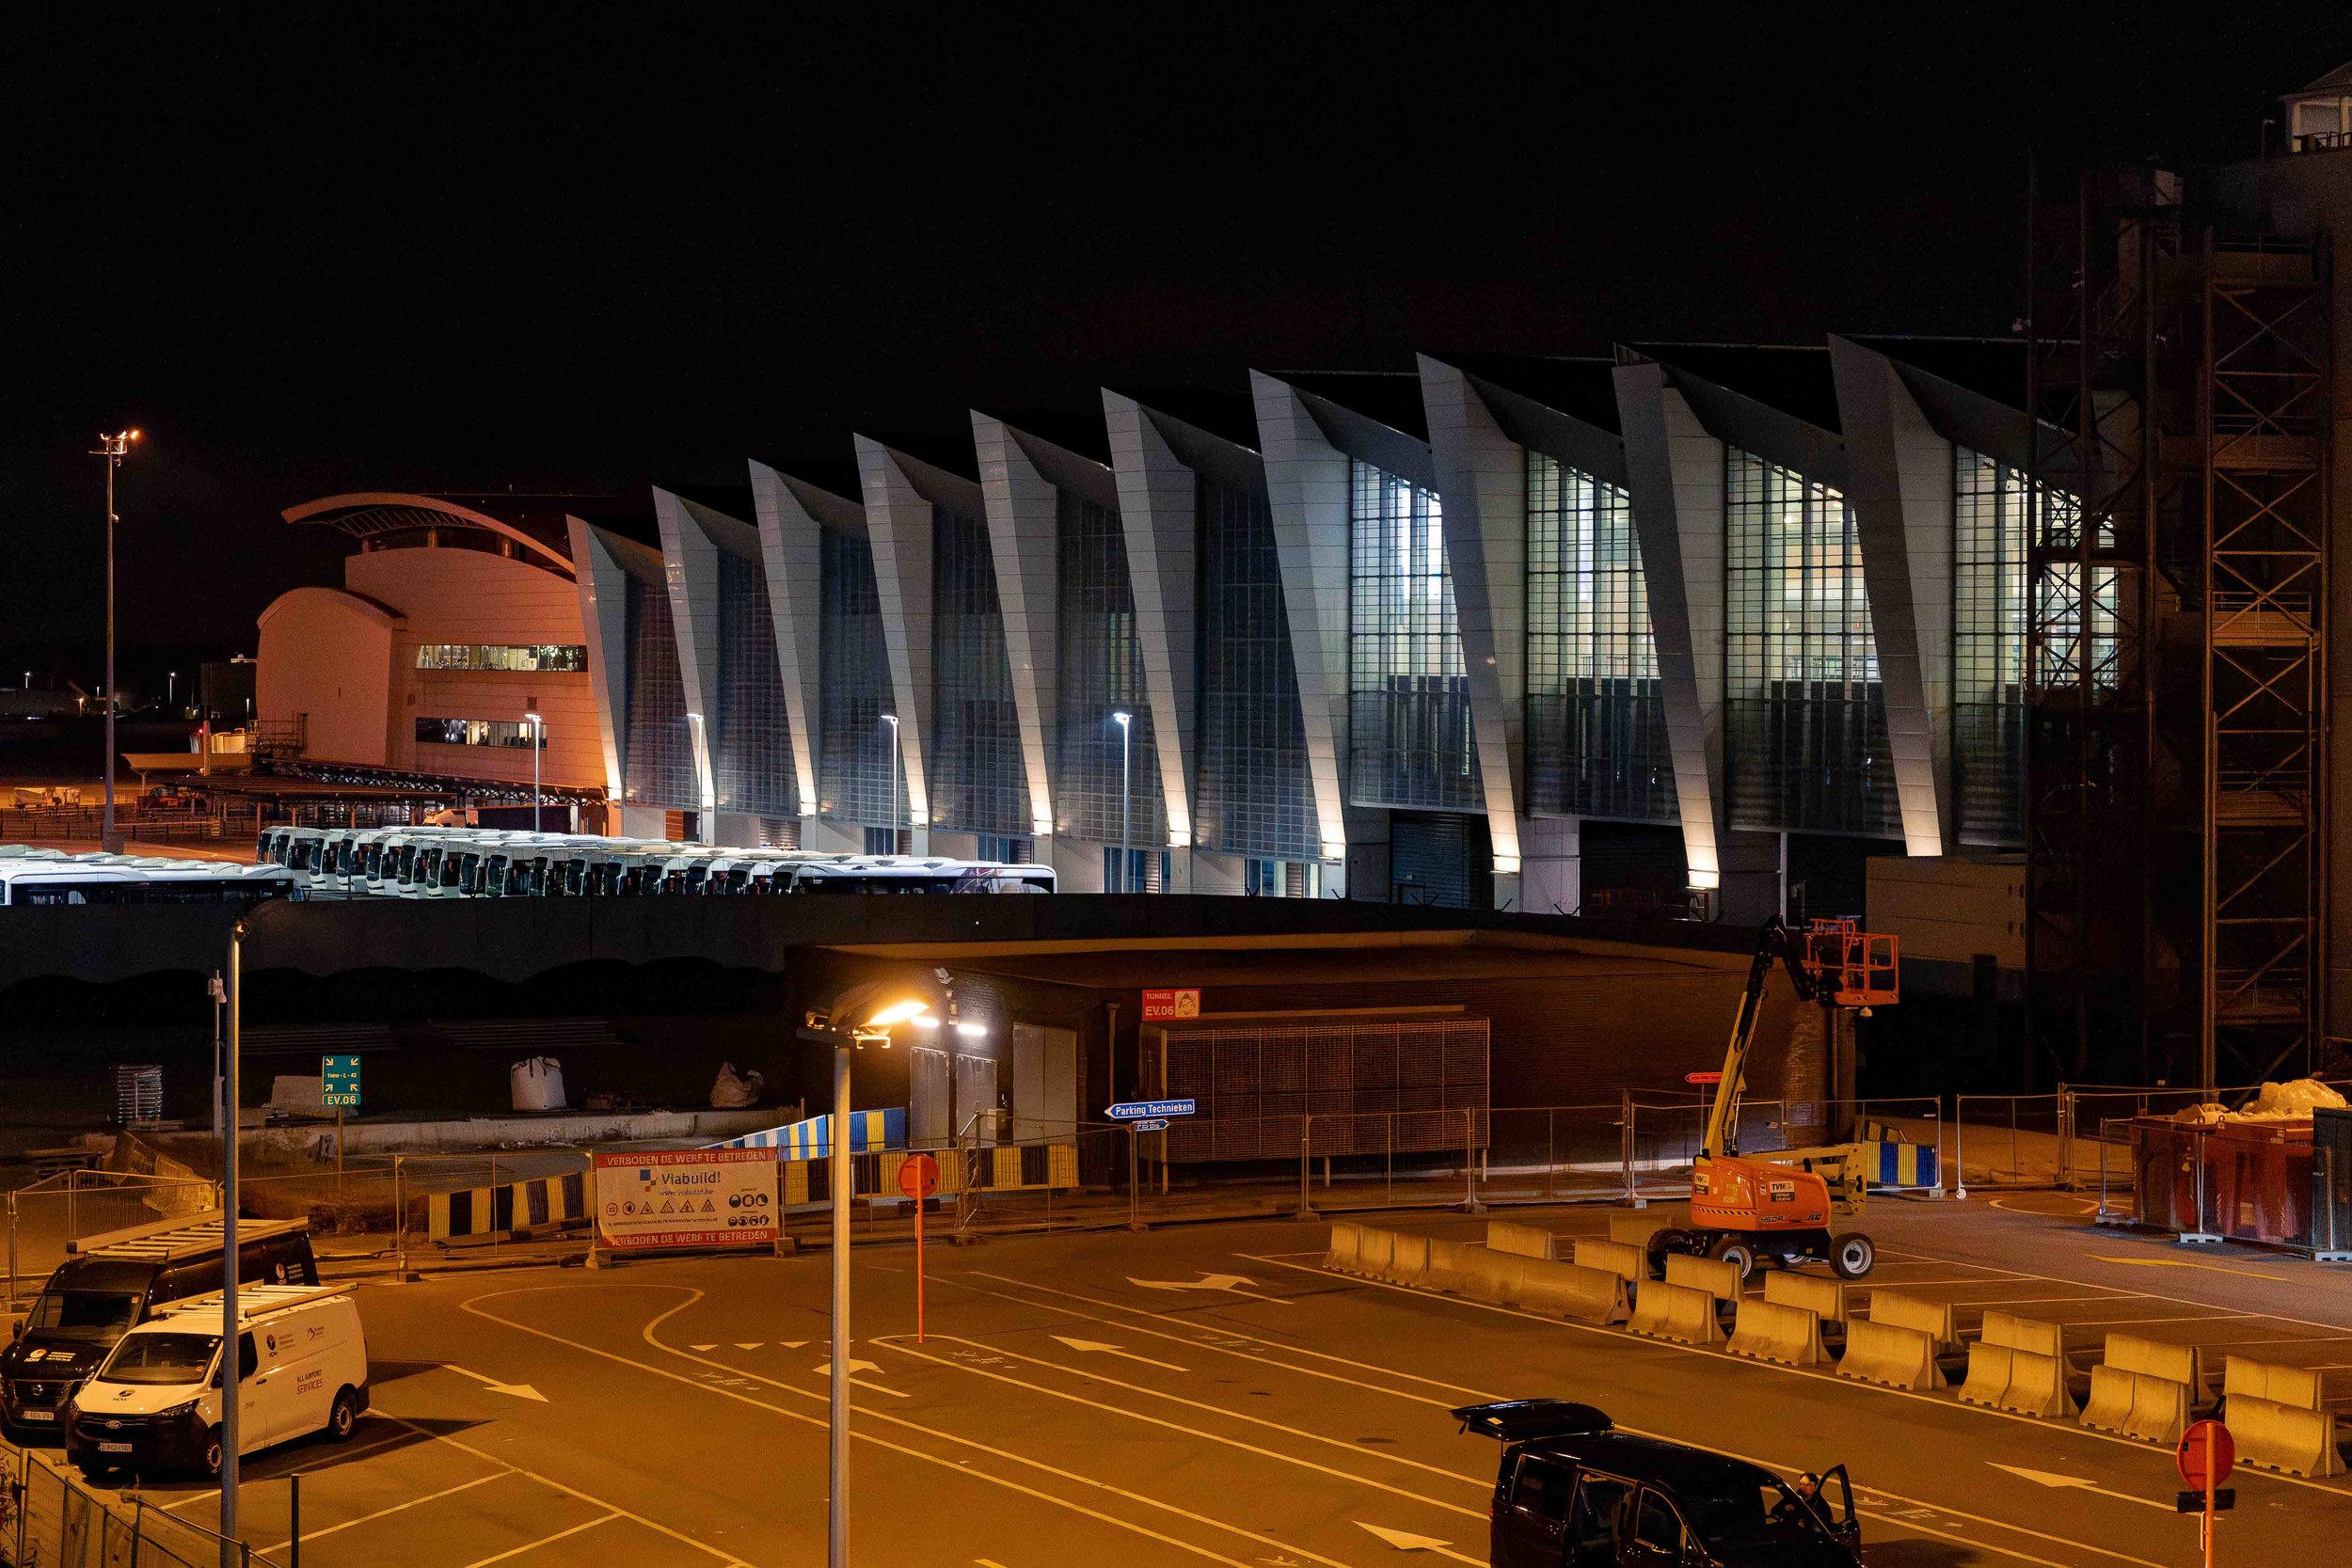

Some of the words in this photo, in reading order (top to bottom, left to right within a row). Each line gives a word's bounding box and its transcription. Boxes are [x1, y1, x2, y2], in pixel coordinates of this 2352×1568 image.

[1145, 1006, 1175, 1016] EV.06
[327, 1095, 357, 1105] EV.06
[1115, 1106, 1147, 1117] Parking
[1148, 1102, 1193, 1114] Technieken
[607, 1155, 659, 1166] VERBODEN
[660, 1154, 674, 1164] DE
[675, 1153, 703, 1164] WERF
[704, 1153, 715, 1163] TE
[718, 1150, 766, 1162] BETREDEN
[661, 1171, 722, 1185] Viabuild!
[1805, 1212, 1822, 1221] JLG
[660, 1234, 674, 1243] DE
[675, 1233, 703, 1243] WERF
[706, 1232, 716, 1242] TE
[718, 1230, 768, 1242] BETREDEN
[296, 1378, 323, 1393] SERVICES
